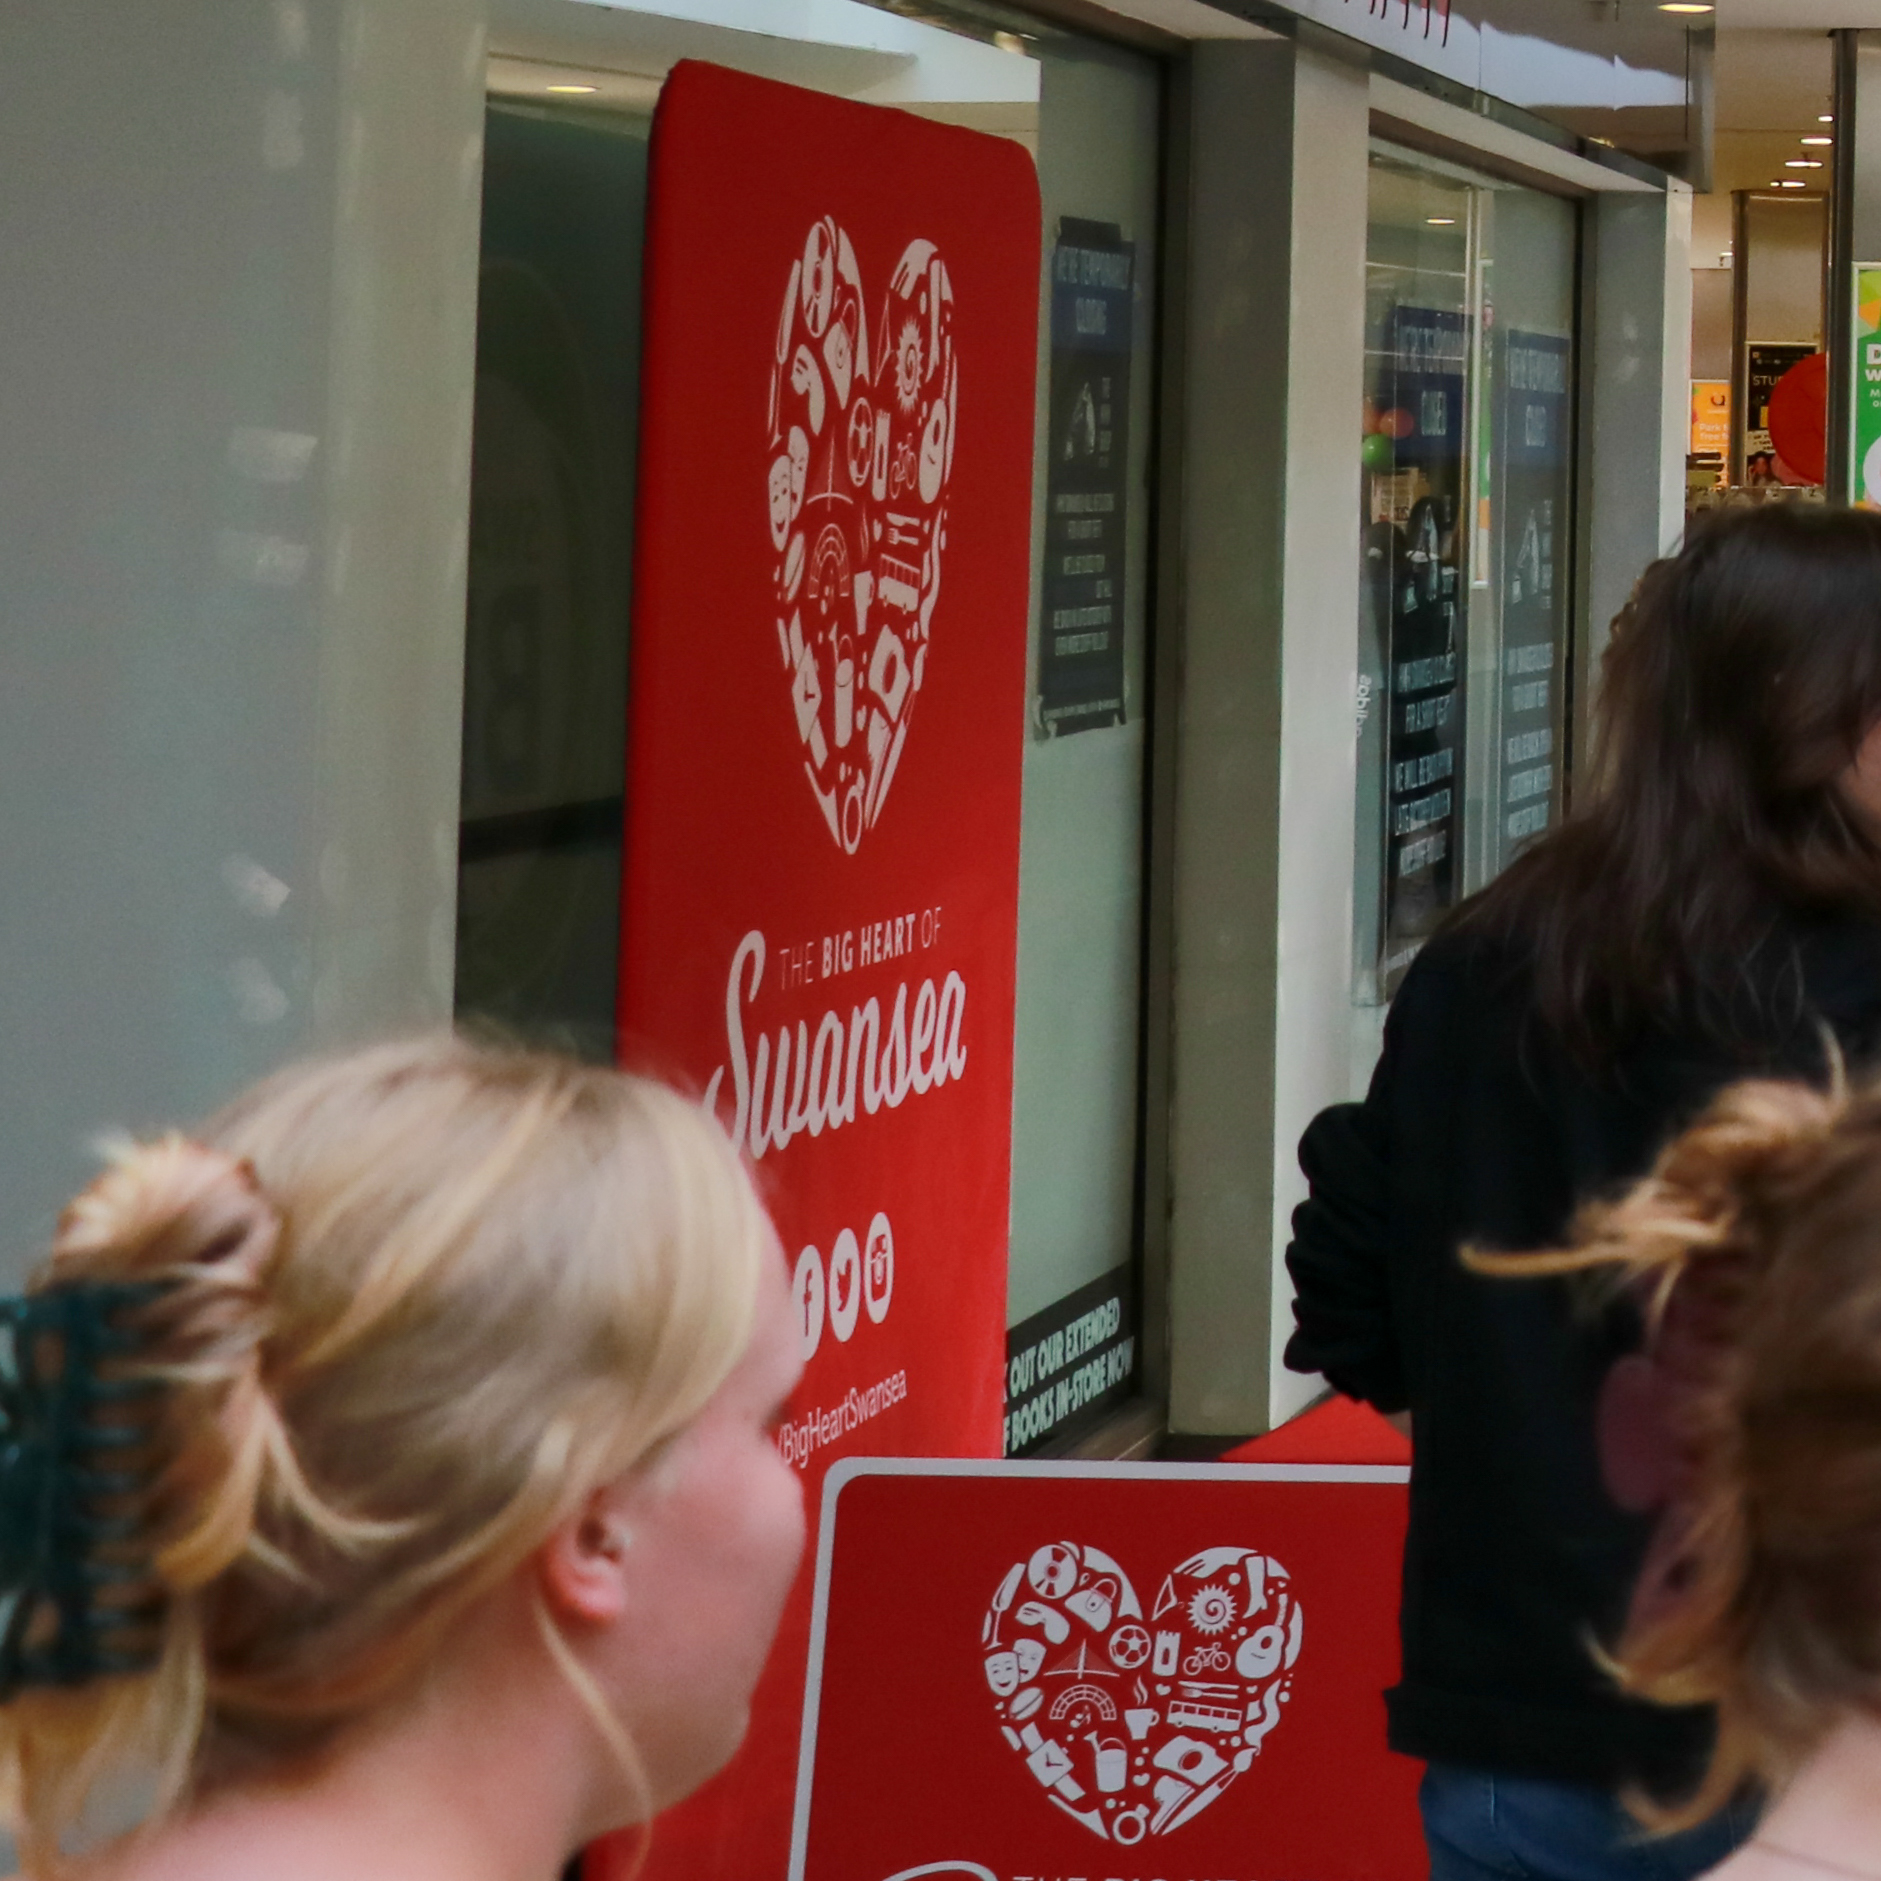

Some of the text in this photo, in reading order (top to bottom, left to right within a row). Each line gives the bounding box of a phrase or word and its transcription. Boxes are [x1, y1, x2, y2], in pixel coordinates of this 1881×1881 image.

[779, 906, 941, 990] THE BIG HEART OF
[702, 929, 967, 1160] Swansea
[1010, 1345, 1037, 1398] OUT
[1038, 1330, 1065, 1380] OUR
[1065, 1297, 1121, 1364] EXTENDED
[1011, 1386, 1054, 1452] BOOKS
[1056, 1352, 1106, 1422] IN-STORE
[1107, 1335, 1135, 1387] NOW
